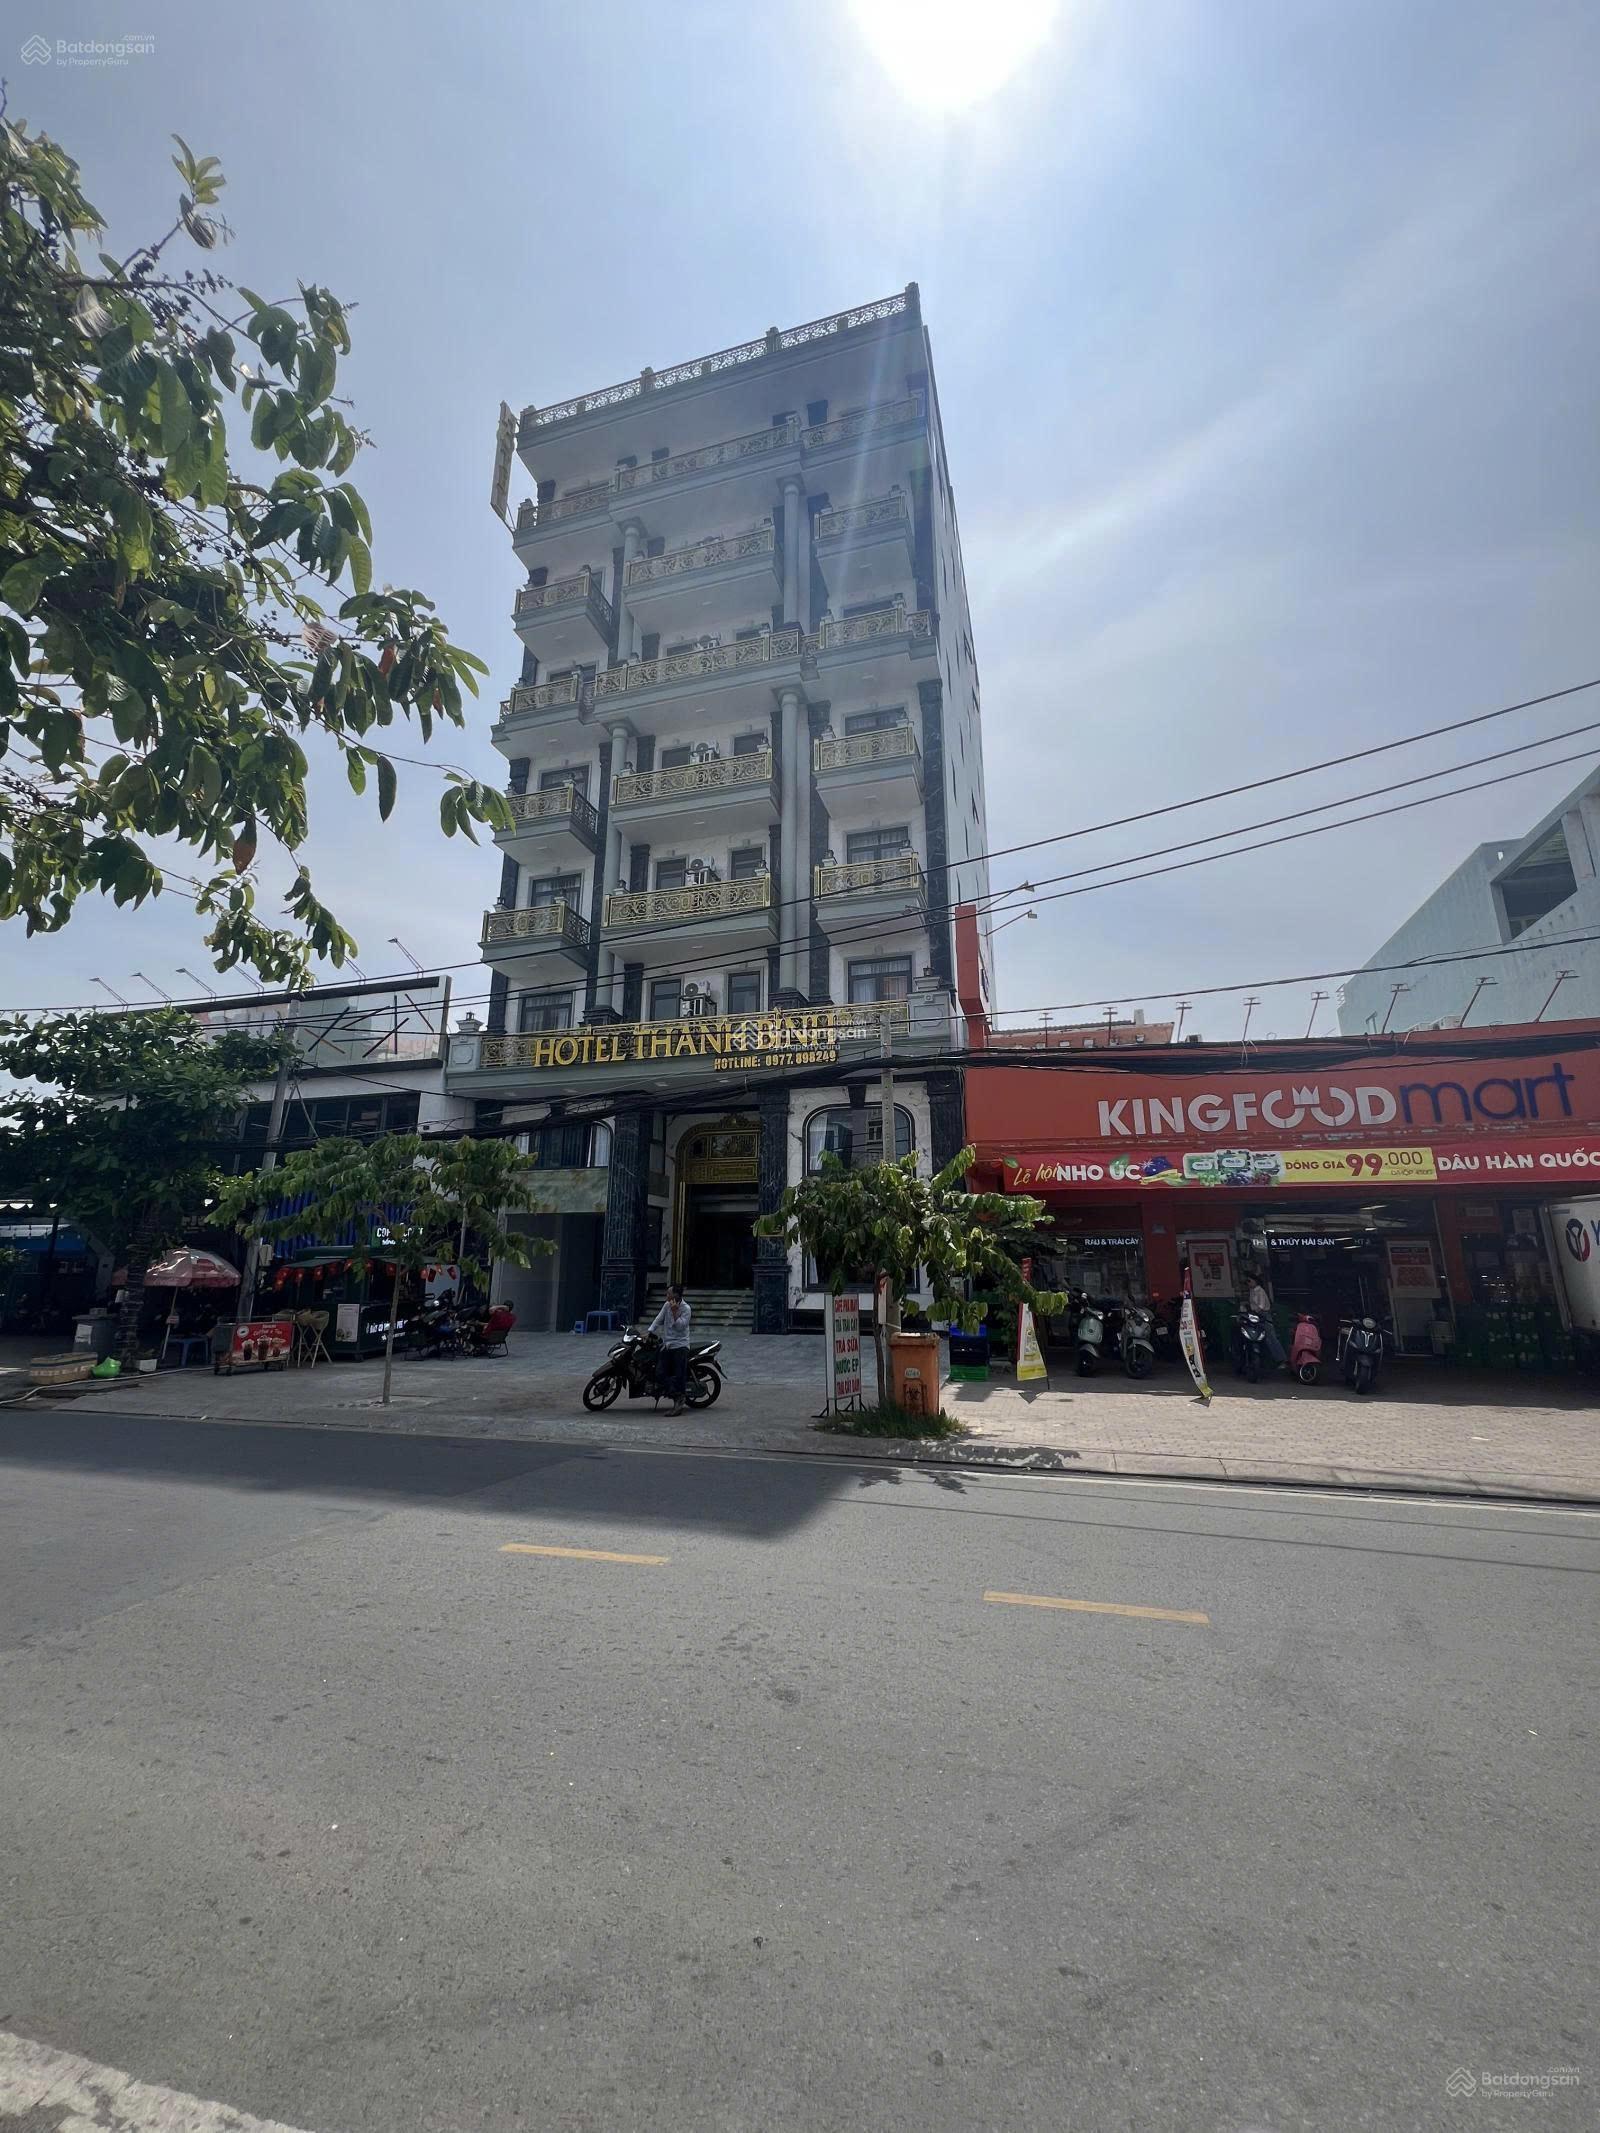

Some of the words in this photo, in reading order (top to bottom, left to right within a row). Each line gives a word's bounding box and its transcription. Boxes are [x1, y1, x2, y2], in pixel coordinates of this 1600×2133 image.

[533, 1034, 628, 1068] HOTEL
[634, 1022, 751, 1060] THANH
[1437, 1153, 1480, 1171] DÂU
[1485, 1151, 1534, 1169] HÀN
[1539, 1147, 1600, 1168] QUỐC
[1013, 1167, 1031, 1186] Lễ
[1035, 1162, 1060, 1182] hội
[1057, 1164, 1104, 1182] NHO
[1100, 1238, 1107, 1246] &
[836, 1338, 846, 1354] TRÀ
